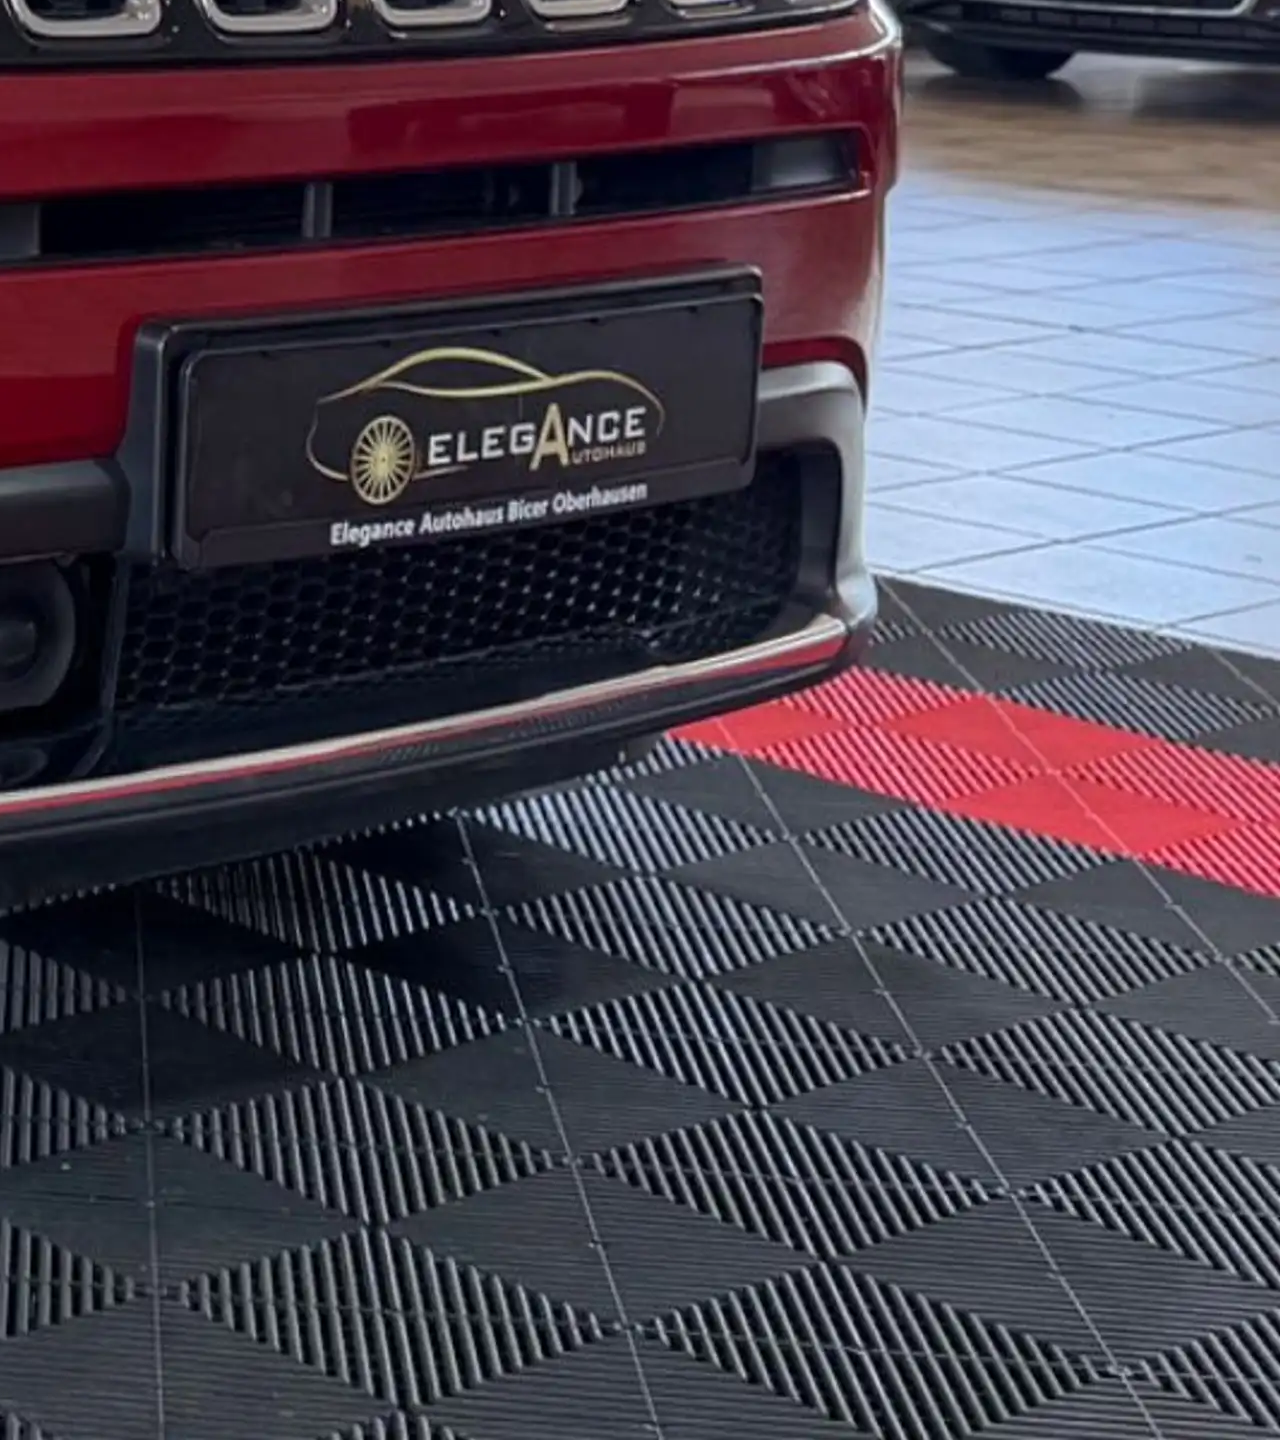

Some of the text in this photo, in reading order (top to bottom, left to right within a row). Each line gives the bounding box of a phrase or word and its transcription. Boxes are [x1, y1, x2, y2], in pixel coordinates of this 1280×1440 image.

[427, 402, 647, 472] ELEGANCE
[329, 519, 415, 548] Elegance
[419, 503, 505, 536] Autohaus
[552, 482, 648, 513] Oberhausen
